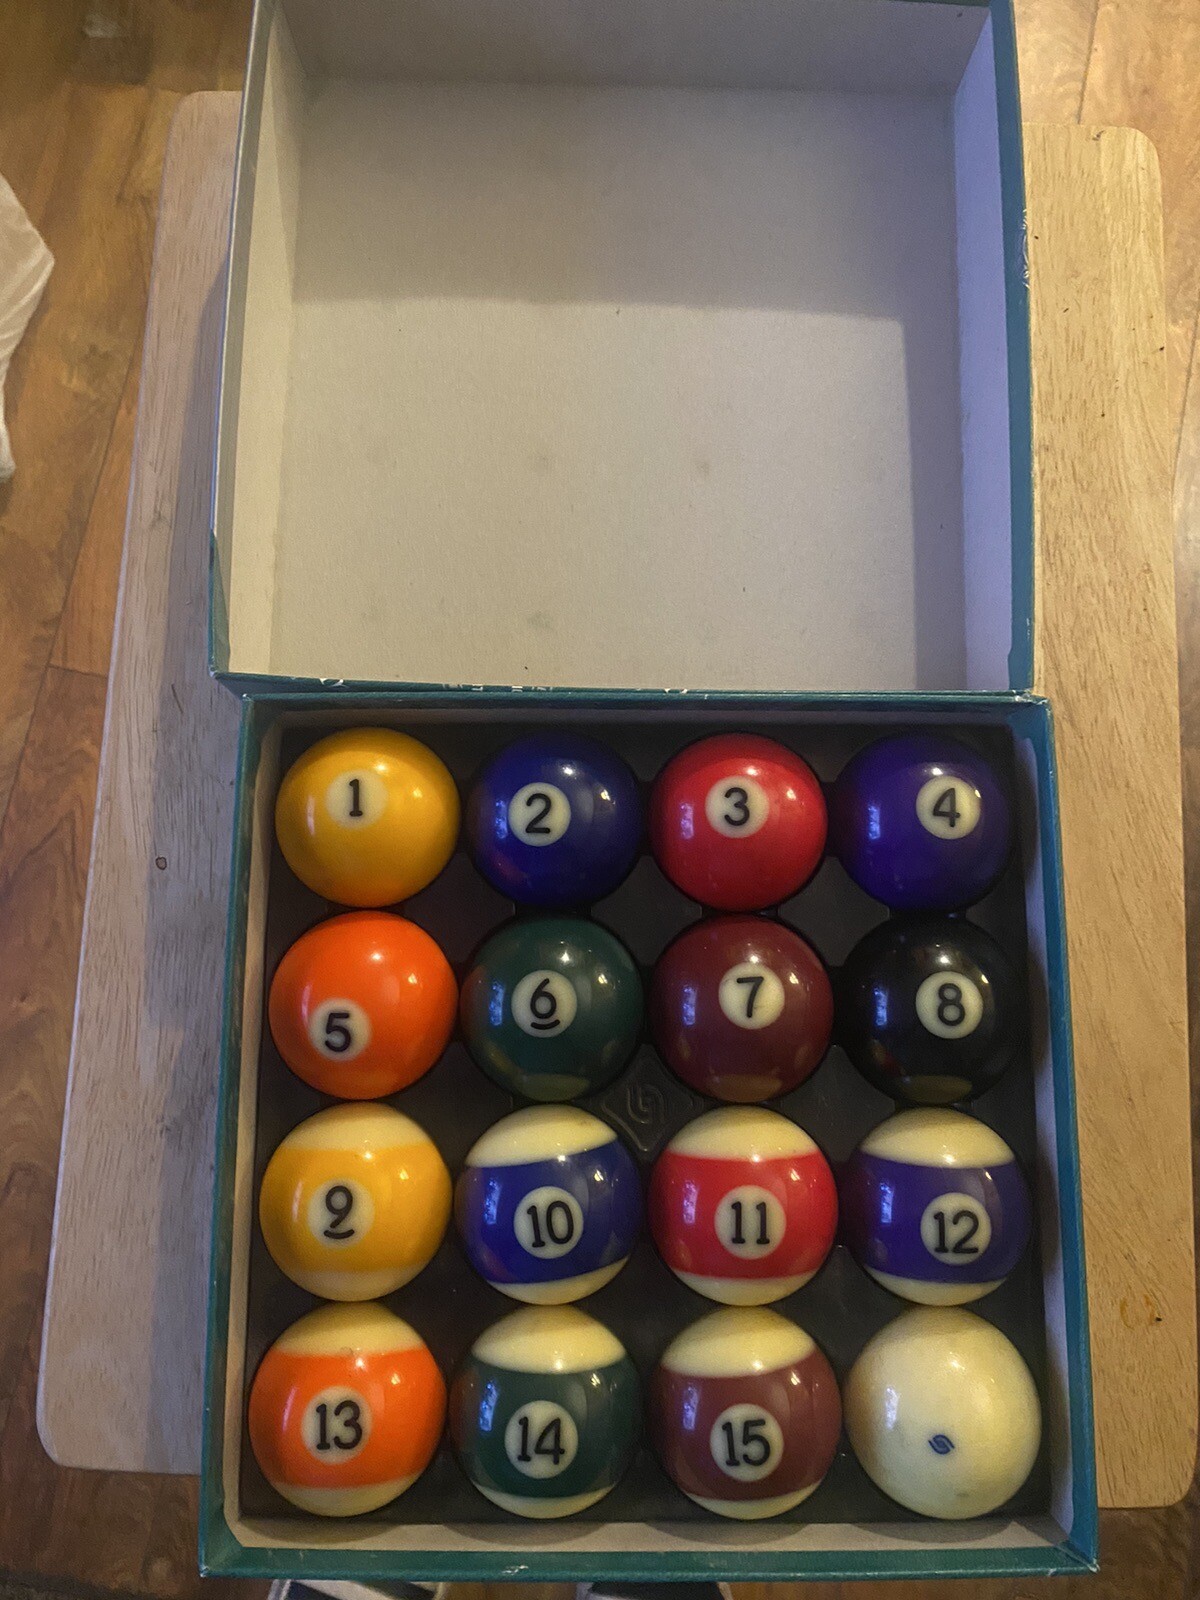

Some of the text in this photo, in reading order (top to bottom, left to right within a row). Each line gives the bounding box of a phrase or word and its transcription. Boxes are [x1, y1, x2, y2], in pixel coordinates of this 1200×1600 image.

[348, 778, 364, 818] 1
[525, 792, 552, 834] 2
[724, 787, 750, 829] 3
[931, 788, 961, 828] 4
[530, 978, 560, 1030] 6
[736, 976, 764, 1019] 7
[936, 983, 966, 1027] 8
[323, 1012, 350, 1053] 5
[323, 1185, 355, 1240] 9
[527, 1201, 574, 1248] 10
[730, 1201, 771, 1246] 11
[933, 1209, 979, 1255] 12
[315, 1400, 363, 1450] 13
[516, 1416, 565, 1466] 14
[722, 1419, 771, 1467] 15
